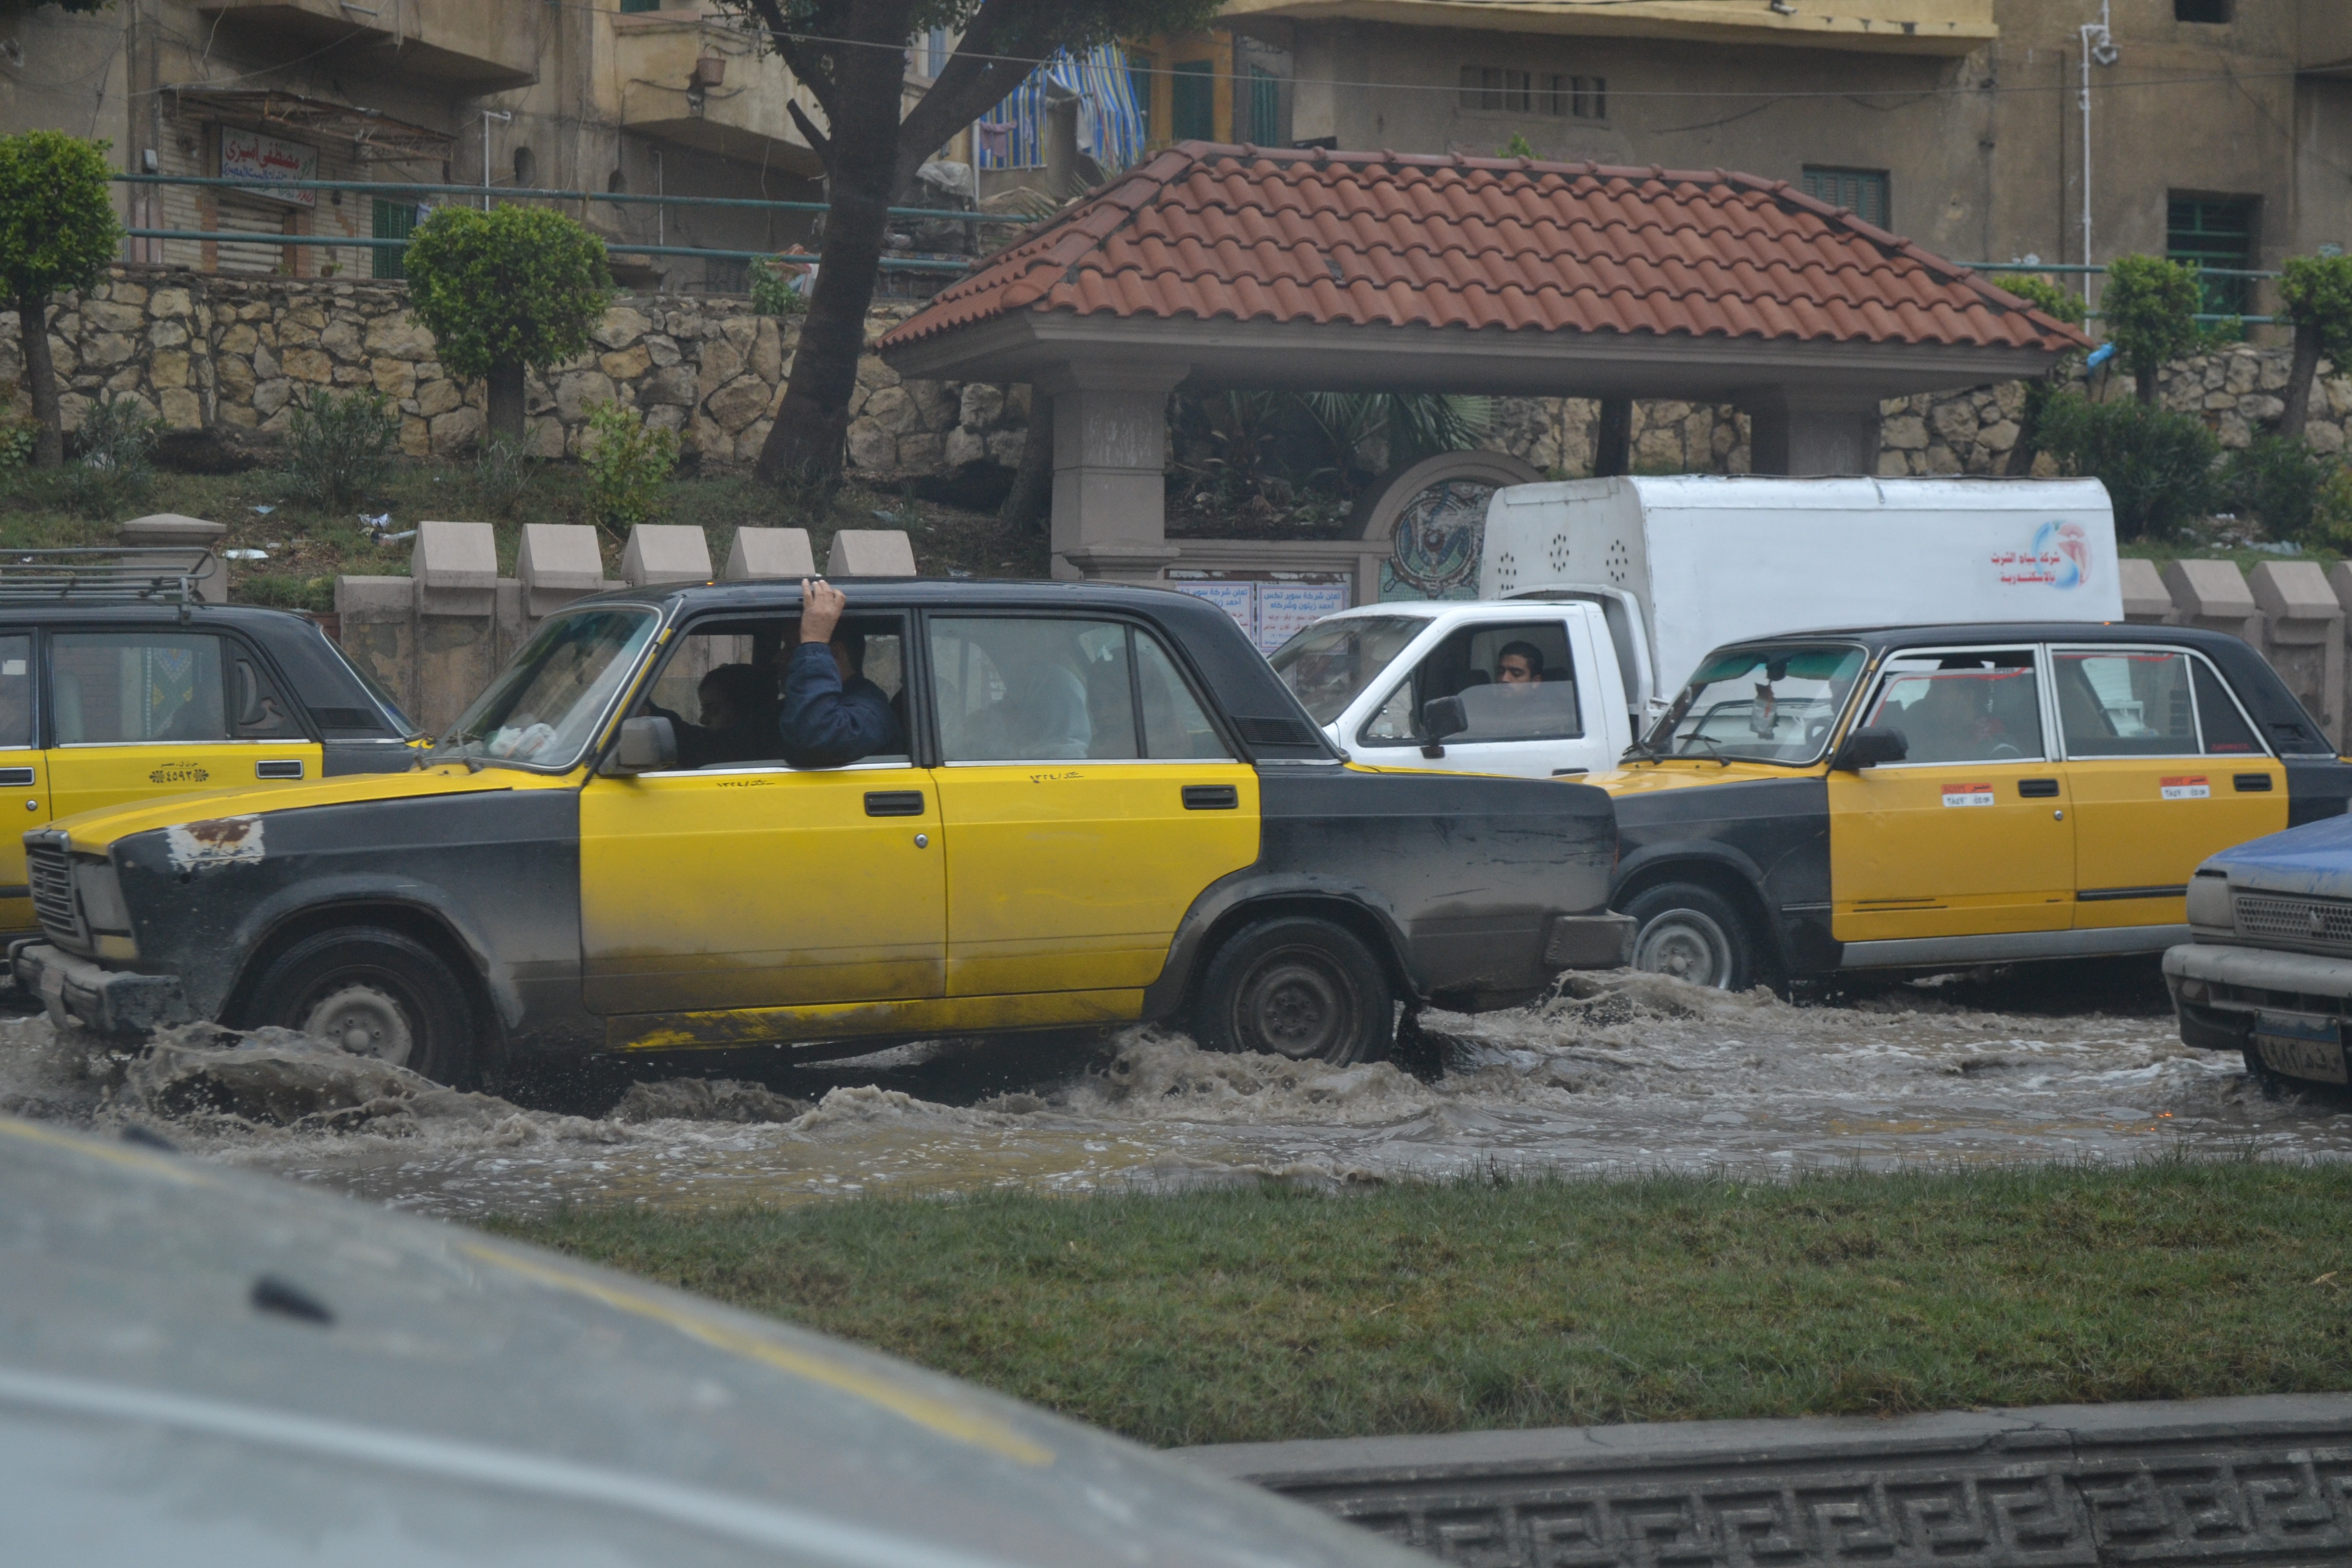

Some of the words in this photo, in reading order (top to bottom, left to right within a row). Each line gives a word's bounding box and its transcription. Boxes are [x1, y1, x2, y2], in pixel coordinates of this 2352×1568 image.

[1210, 588, 1231, 597] شركة
[1233, 588, 1247, 597] تعلن
[1304, 592, 1324, 600] شركة
[1326, 592, 1341, 600] تعلن
